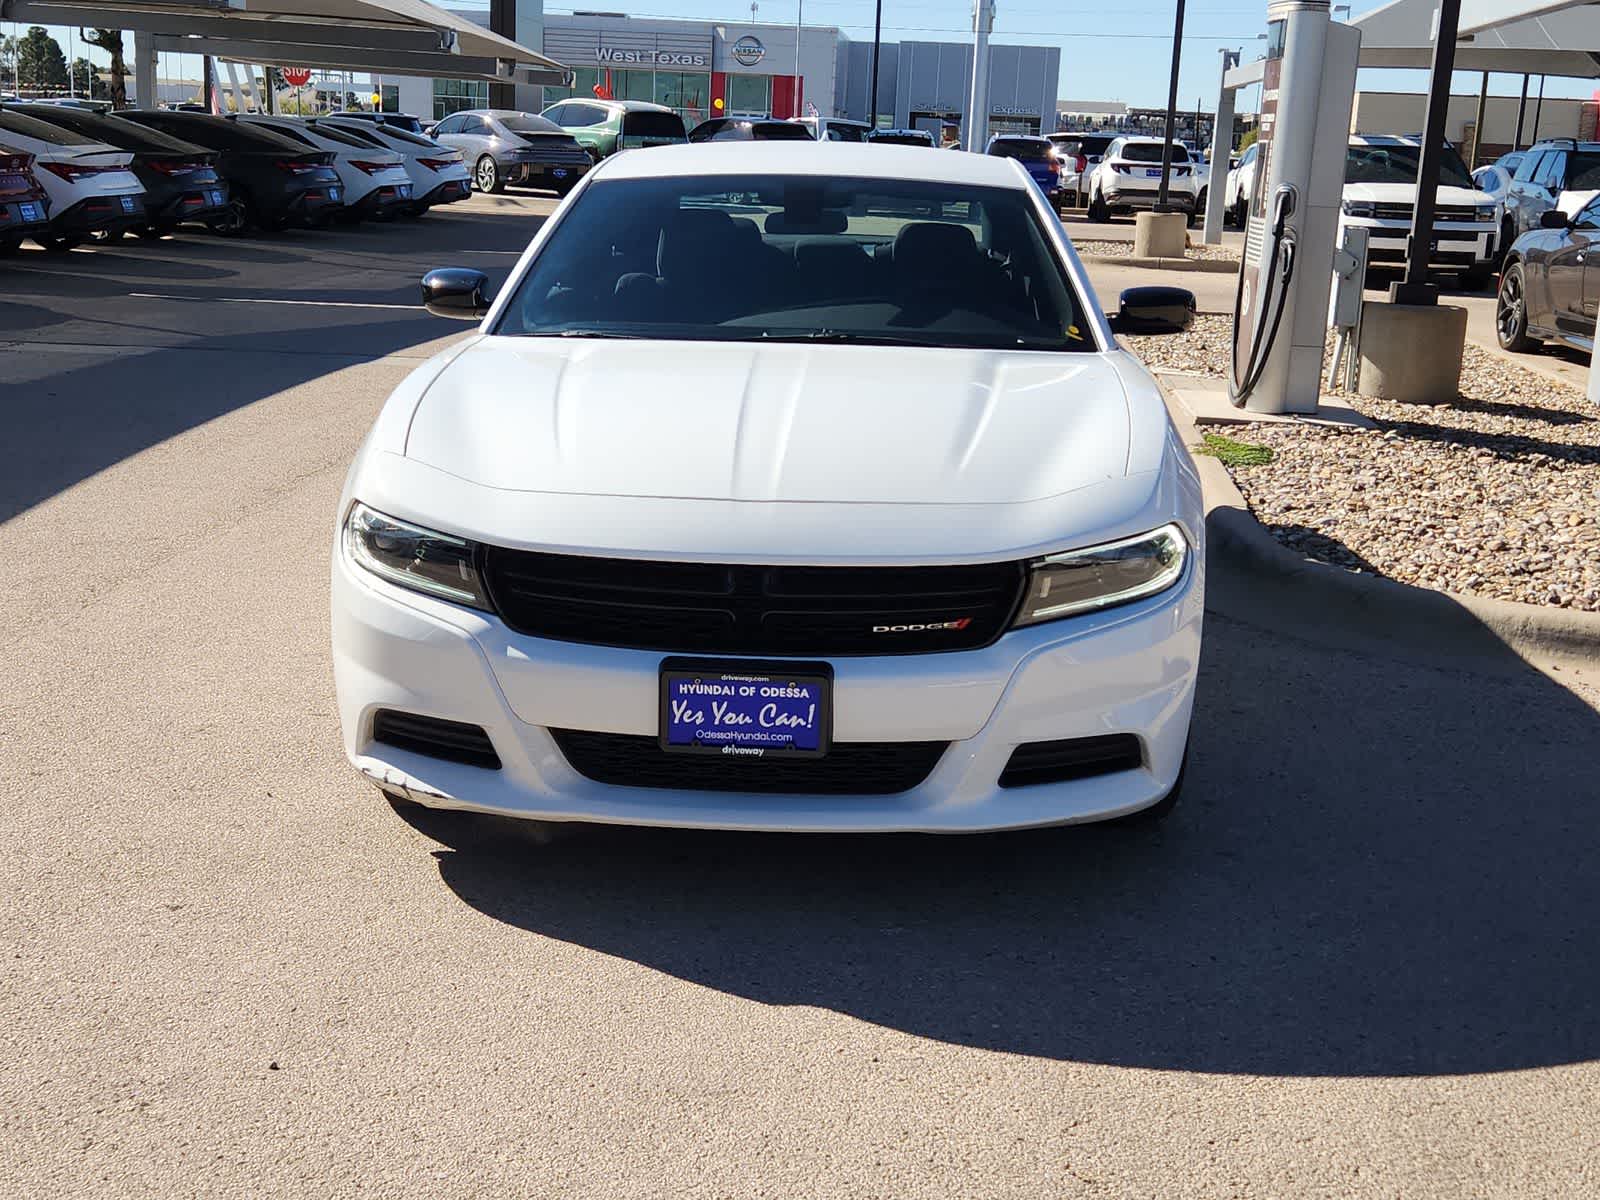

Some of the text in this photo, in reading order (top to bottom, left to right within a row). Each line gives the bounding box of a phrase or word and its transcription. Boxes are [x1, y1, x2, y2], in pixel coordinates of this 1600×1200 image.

[594, 47, 705, 66] West Texas
[285, 67, 309, 77] STOP
[872, 621, 957, 633] DODGE
[721, 674, 770, 683] driveway.com
[679, 684, 809, 698] HYUNDAI OF ODESSA
[671, 699, 816, 729] Yes You Can!
[696, 729, 793, 742] OdessaHyundai.com
[721, 745, 765, 757] driveway
